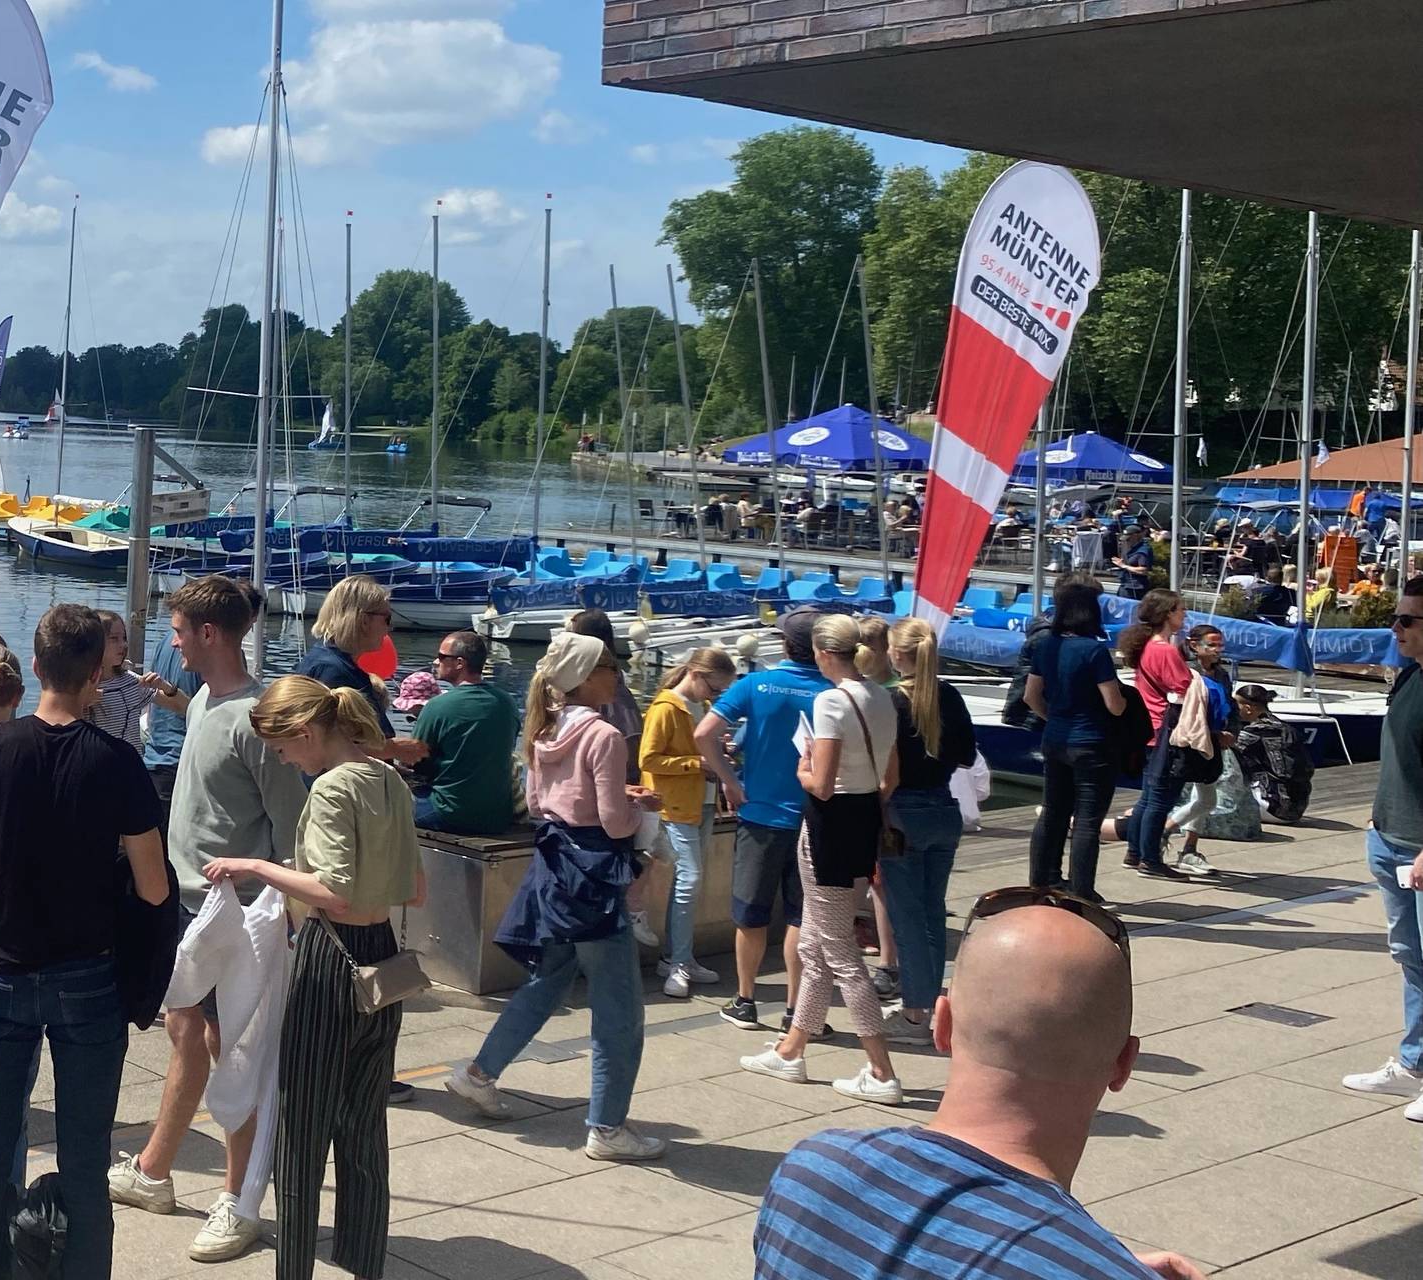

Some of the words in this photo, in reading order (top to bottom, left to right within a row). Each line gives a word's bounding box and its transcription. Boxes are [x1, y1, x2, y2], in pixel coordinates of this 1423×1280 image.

[989, 225, 1079, 309] MÜNSTER
[999, 203, 1091, 290] ANTENNE
[980, 254, 1004, 276] 95.4
[1004, 272, 1030, 298] MHz
[976, 280, 1000, 306] DER
[999, 297, 1031, 331] BESTE
[1304, 728, 1318, 744] 7
